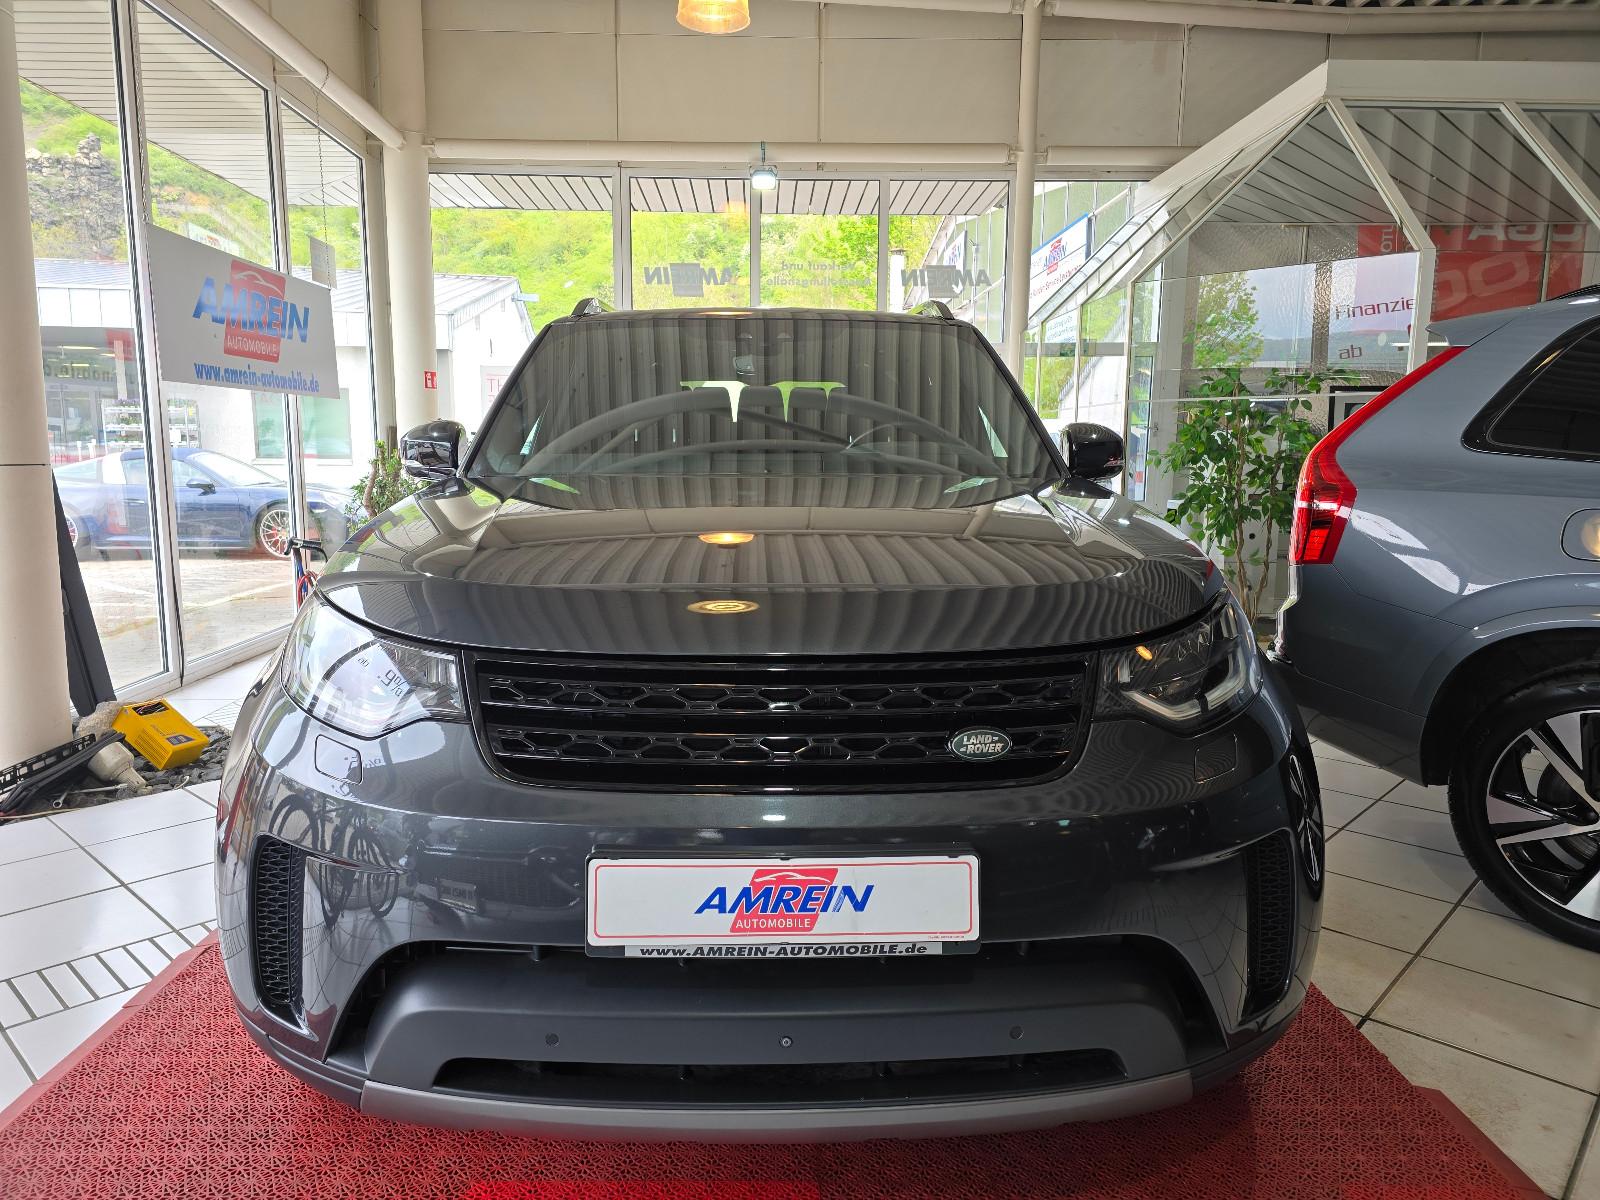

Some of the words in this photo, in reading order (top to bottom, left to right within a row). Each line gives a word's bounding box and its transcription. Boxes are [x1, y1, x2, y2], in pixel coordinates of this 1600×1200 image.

[192, 276, 310, 343] AMREIN
[227, 334, 278, 358] AUTOMOBILE
[1338, 344, 1363, 360] ab
[194, 362, 320, 393] www.amrein-automobile.de
[963, 735, 993, 745] LAND
[966, 743, 1005, 754] ROVER
[694, 884, 875, 915] AMREIN
[735, 917, 812, 929] AUTOMOBILE
[639, 943, 928, 957] www.AMREIN-AUTOMOBILE.de
